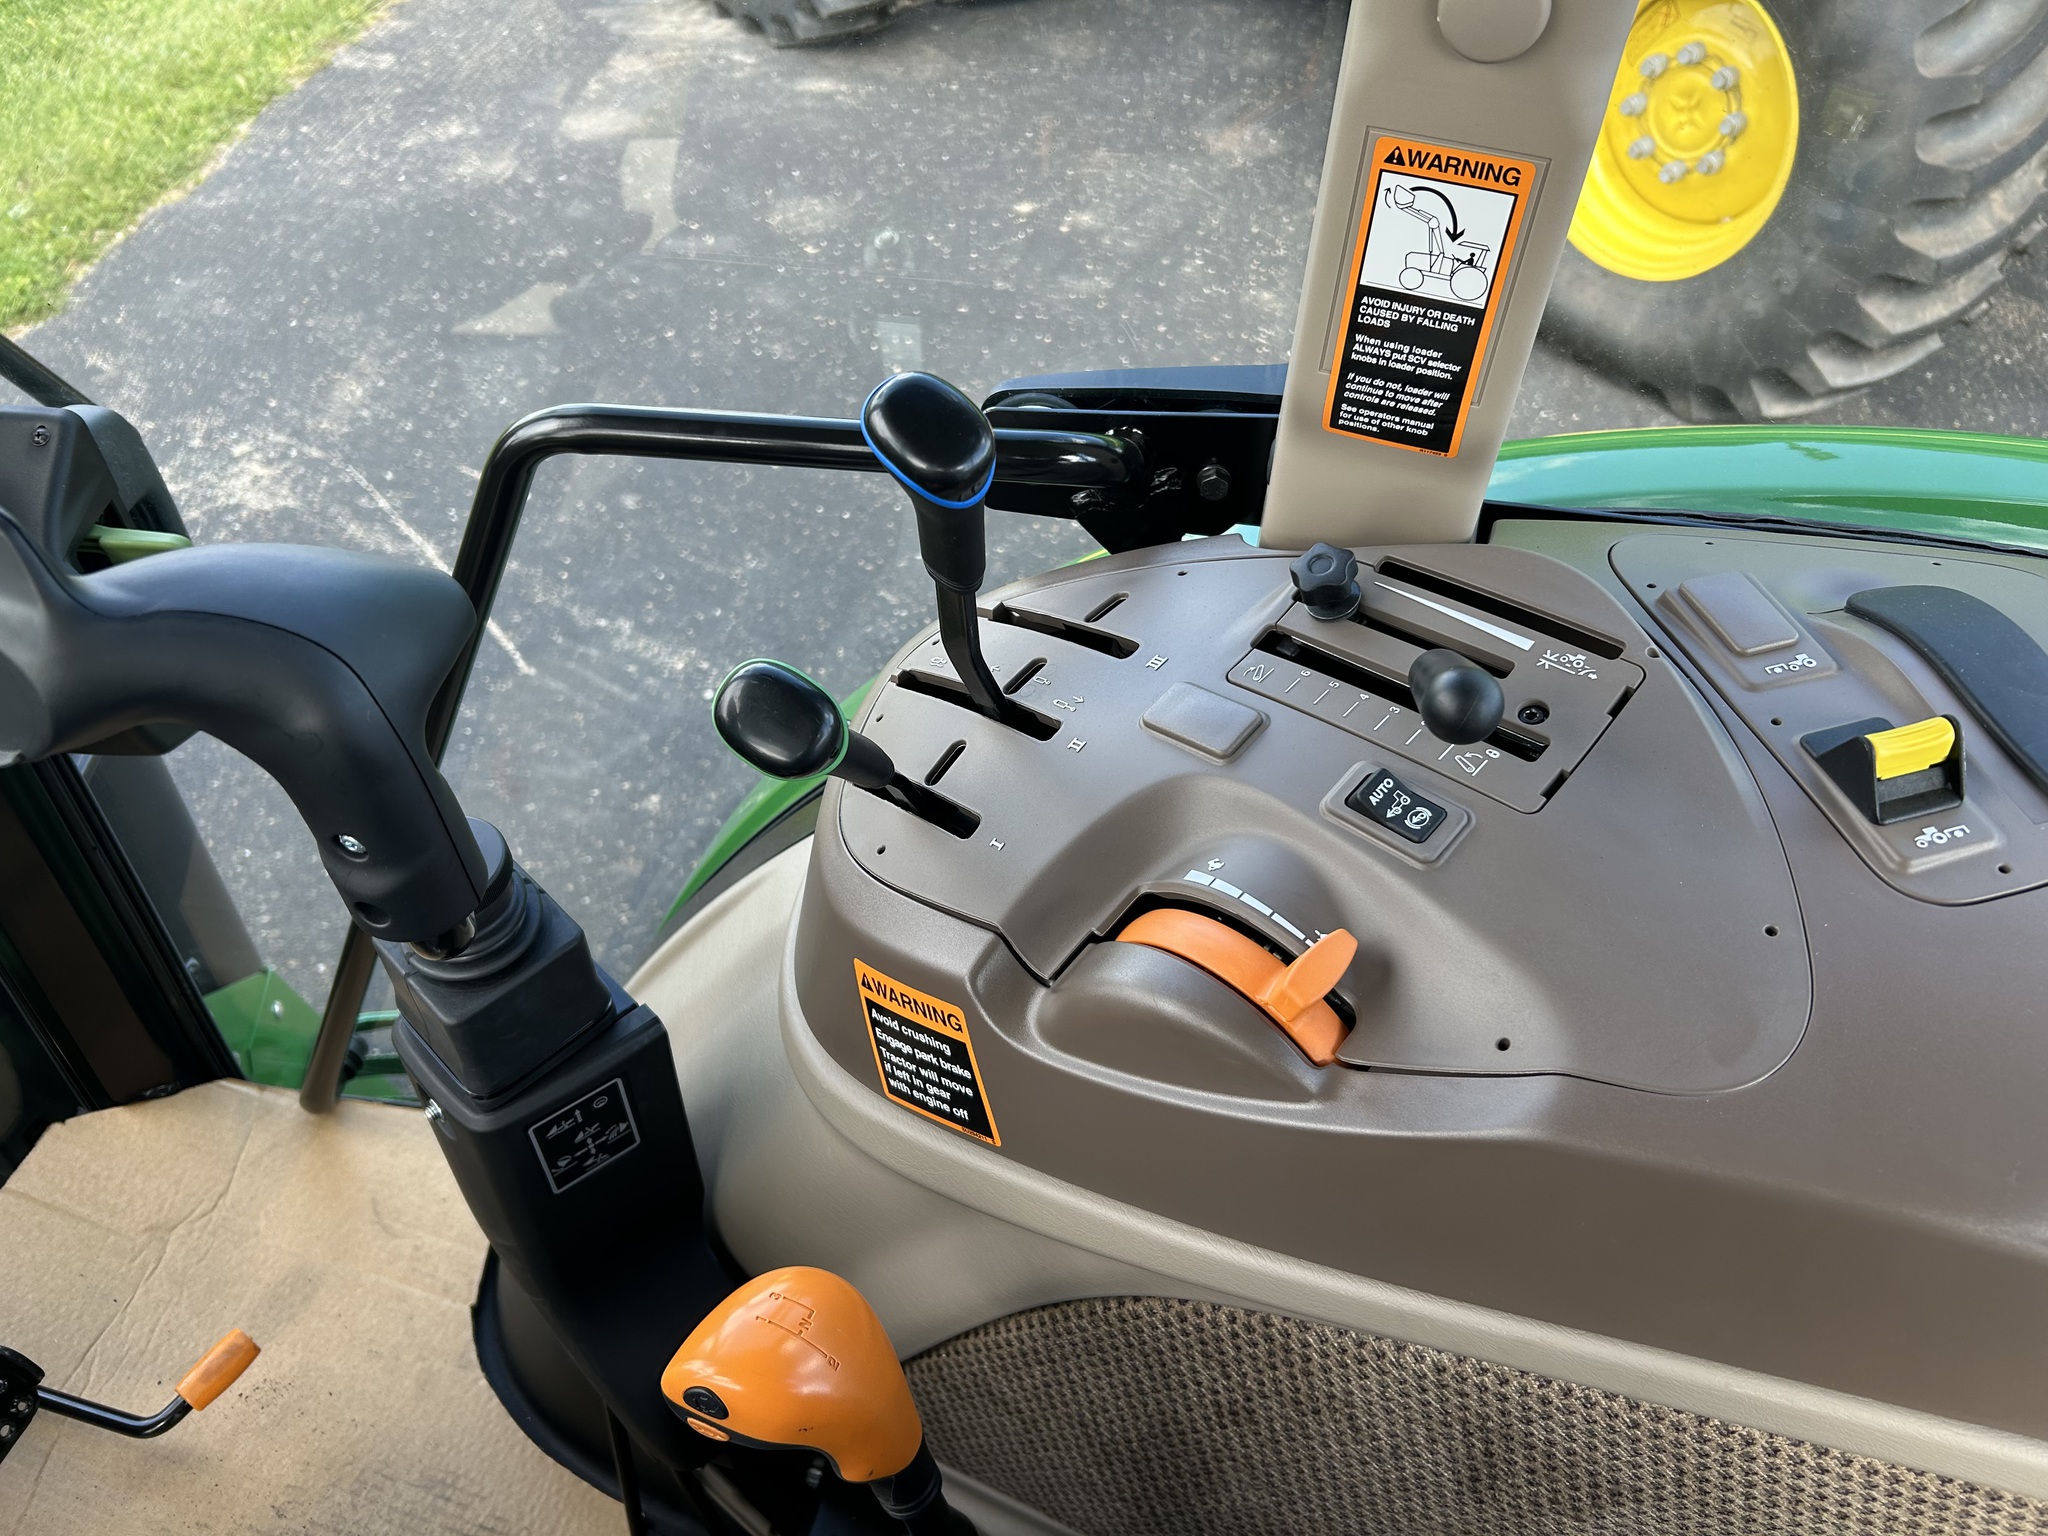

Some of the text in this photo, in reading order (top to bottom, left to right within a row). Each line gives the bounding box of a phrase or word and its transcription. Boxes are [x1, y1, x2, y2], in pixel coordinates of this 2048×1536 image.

[1408, 149, 1522, 186] WARNING
[1357, 314, 1391, 328] LOADS
[1359, 305, 1459, 332] CAUSED BY FALLING
[1361, 296, 1476, 325] AVOID INJURY OR DEATH
[1352, 342, 1462, 372] ALWAYS put SCV selector
[1355, 333, 1443, 358] When using loader
[1351, 352, 1453, 380] knobs in loader position.
[1345, 382, 1384, 395] continue
[1395, 393, 1421, 403] move
[1421, 398, 1444, 408] after
[1347, 372, 1451, 400] If you do not, loader will
[1340, 403, 1435, 429] See operators manual
[1343, 391, 1437, 416] controls are released.
[1338, 419, 1380, 432] positions.
[1339, 411, 1429, 436] for use of other knob
[1300, 669, 1311, 677] 6
[1328, 680, 1340, 688] 5
[1359, 693, 1370, 701] 4
[1389, 706, 1401, 714] 3
[1368, 777, 1395, 807] AUTO
[871, 977, 963, 1033] WARNING
[871, 1008, 952, 1056] Avoid crushing
[875, 1026, 973, 1079] Engage park brake
[879, 1045, 974, 1096] Tractor will move
[883, 1061, 952, 1100] if left in gear
[888, 1077, 970, 1121] with engine off
